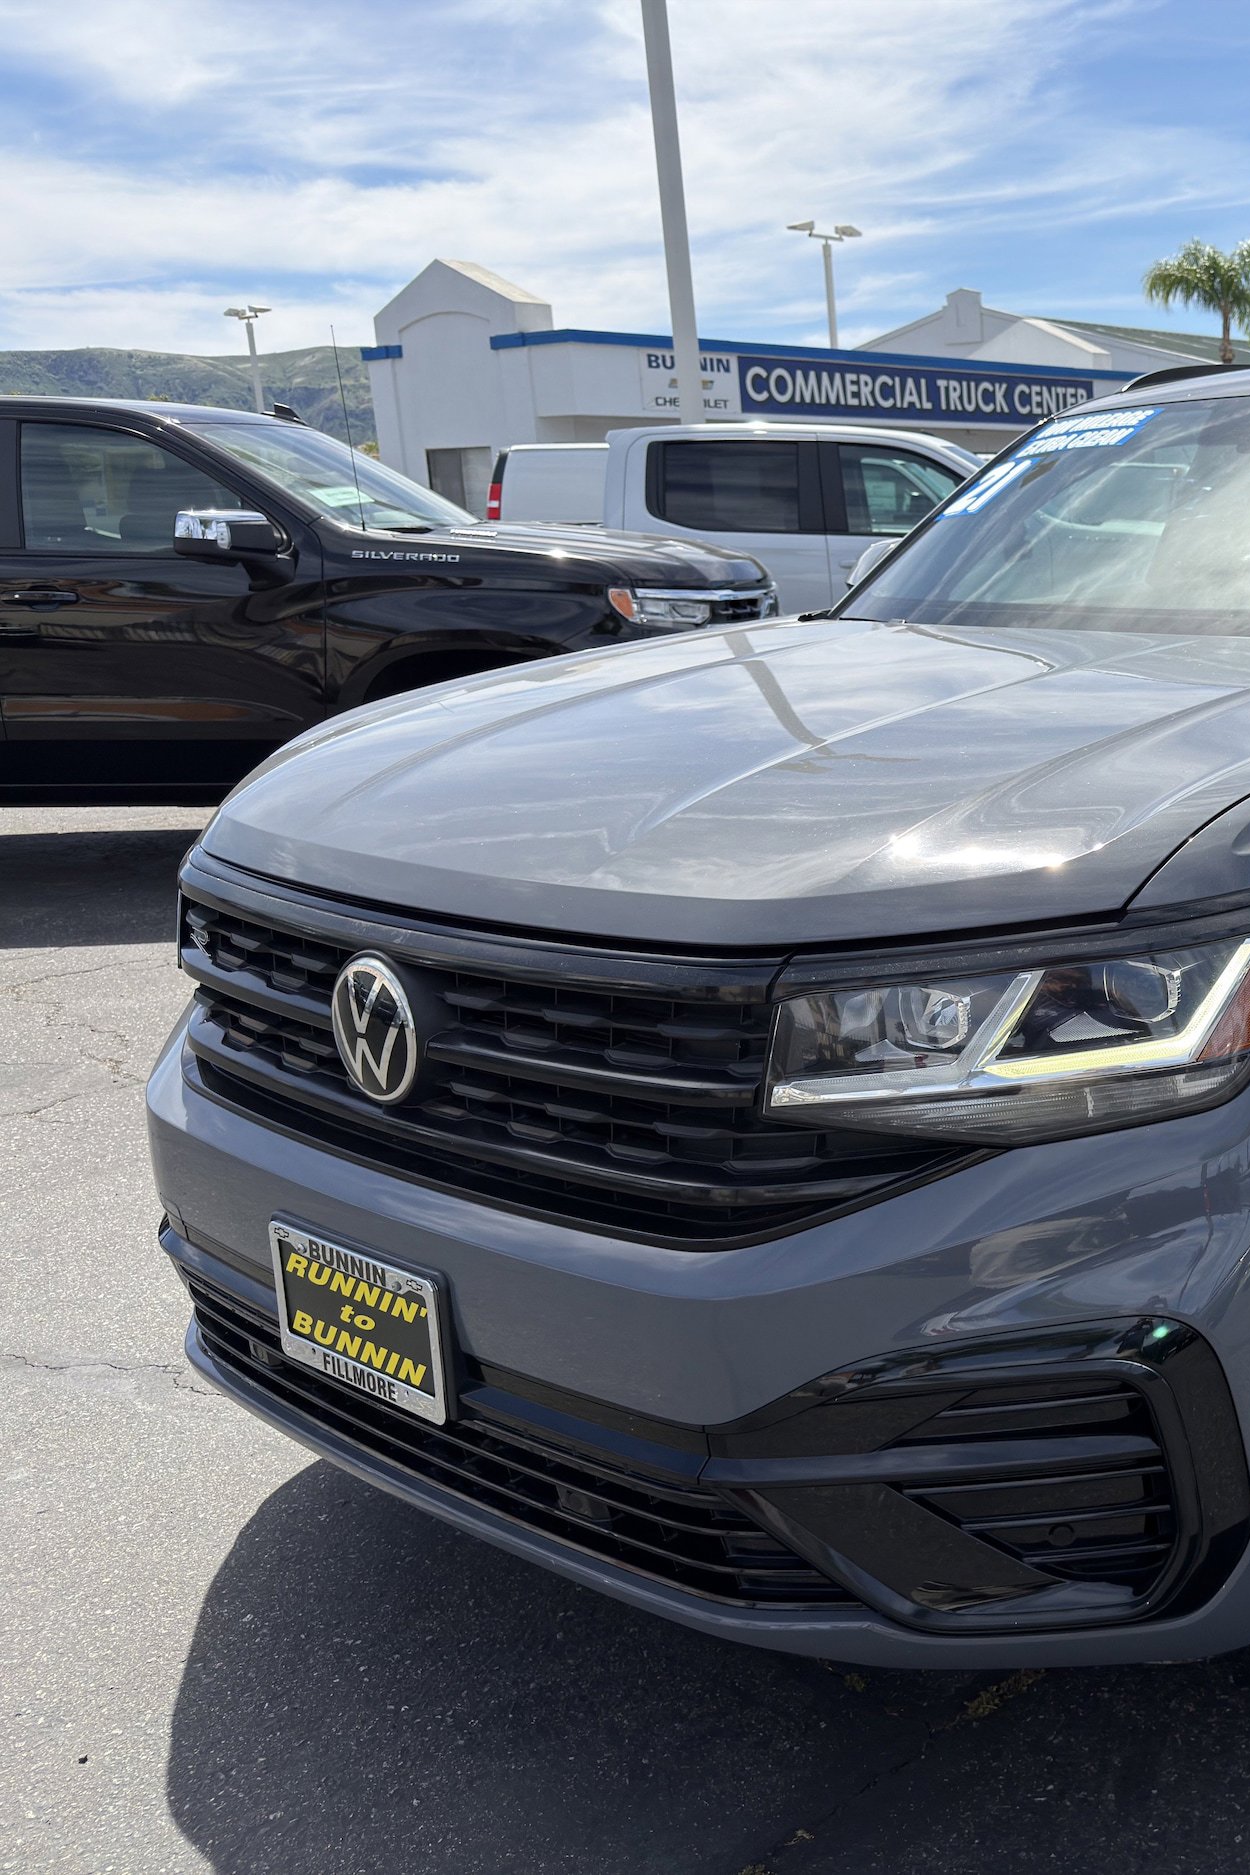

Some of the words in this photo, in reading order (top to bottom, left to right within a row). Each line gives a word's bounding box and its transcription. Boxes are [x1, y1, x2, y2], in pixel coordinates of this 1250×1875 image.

[646, 353, 731, 373] BUNIN
[655, 396, 728, 409] CHELET
[745, 366, 933, 410] COMMERCIAL
[936, 379, 1009, 414] TRUCK
[1067, 427, 1135, 449] CLEAN
[351, 550, 460, 563] SILVERADO
[308, 1239, 387, 1287] BUNNIN
[286, 1252, 428, 1325] RUNNIN'
[340, 1303, 376, 1331] to
[293, 1310, 427, 1387] BUNNIN
[323, 1352, 398, 1402] FILLMORE
